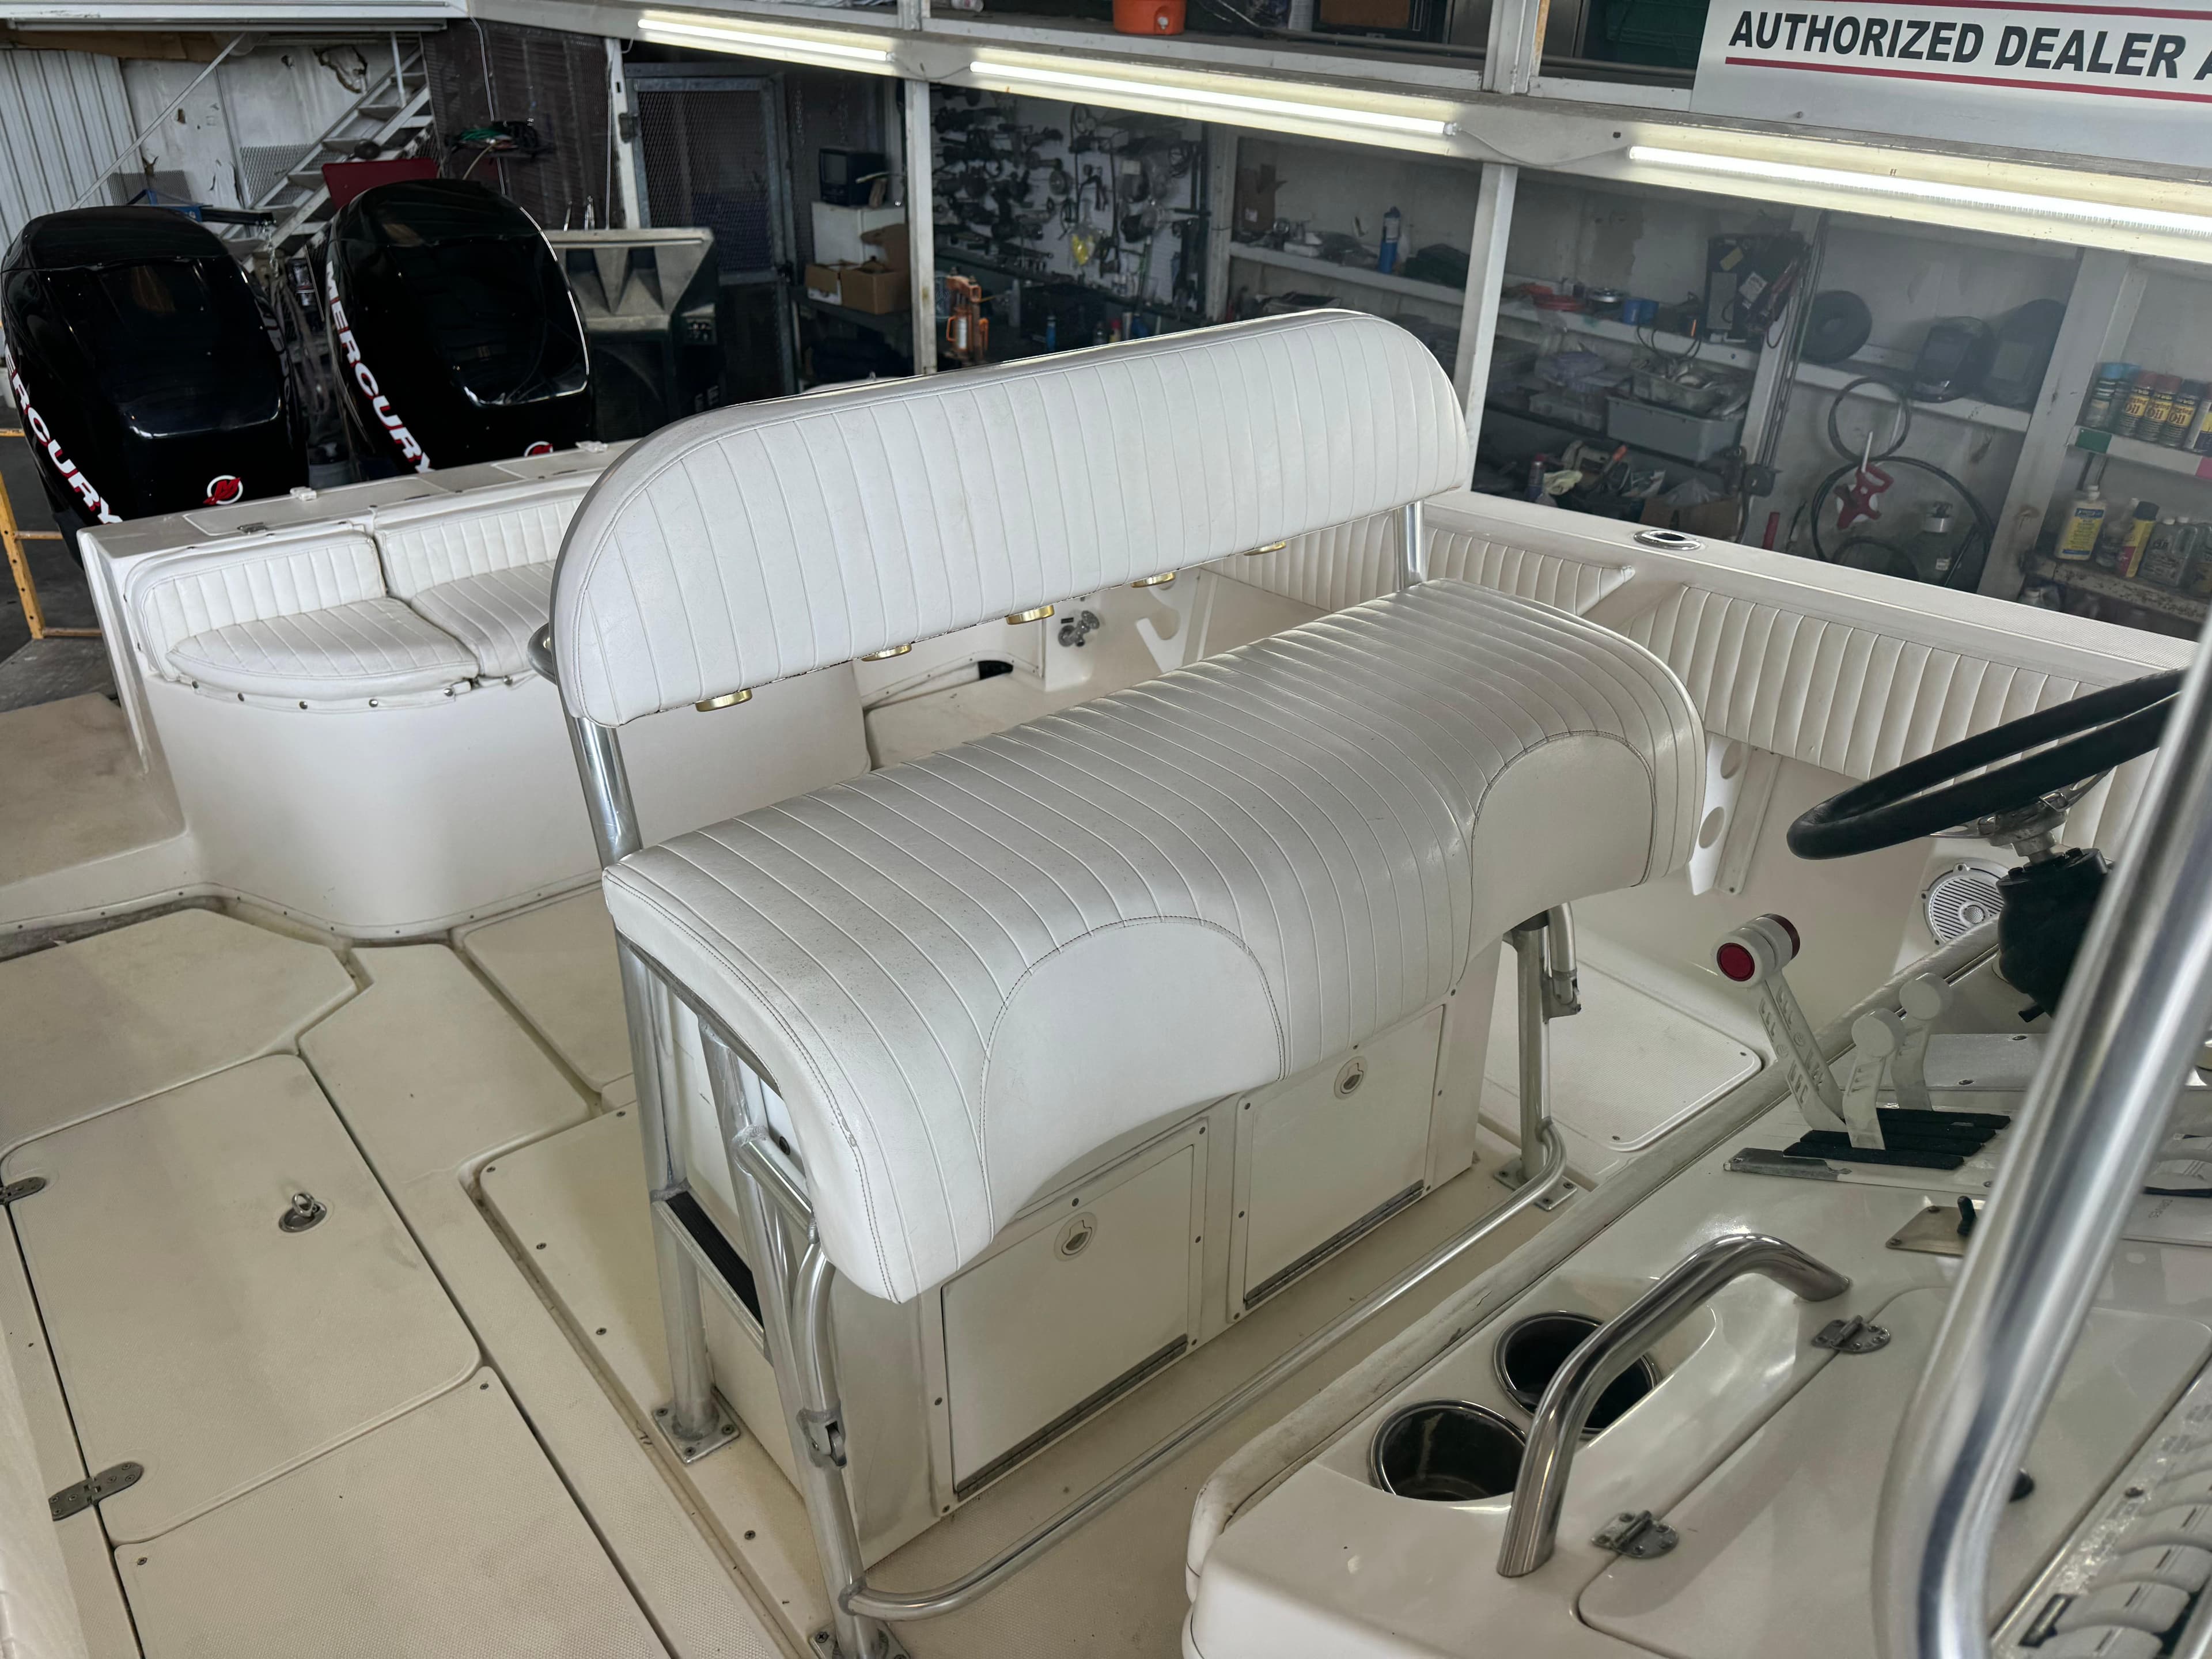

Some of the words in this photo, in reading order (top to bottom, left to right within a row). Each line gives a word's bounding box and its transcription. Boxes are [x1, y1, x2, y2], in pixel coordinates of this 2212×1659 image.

[1728, 10, 1984, 63] AUTHORIZED
[1994, 25, 2187, 79] DEALER
[5, 343, 123, 524] ERCURY
[326, 260, 437, 474] MERCURY
